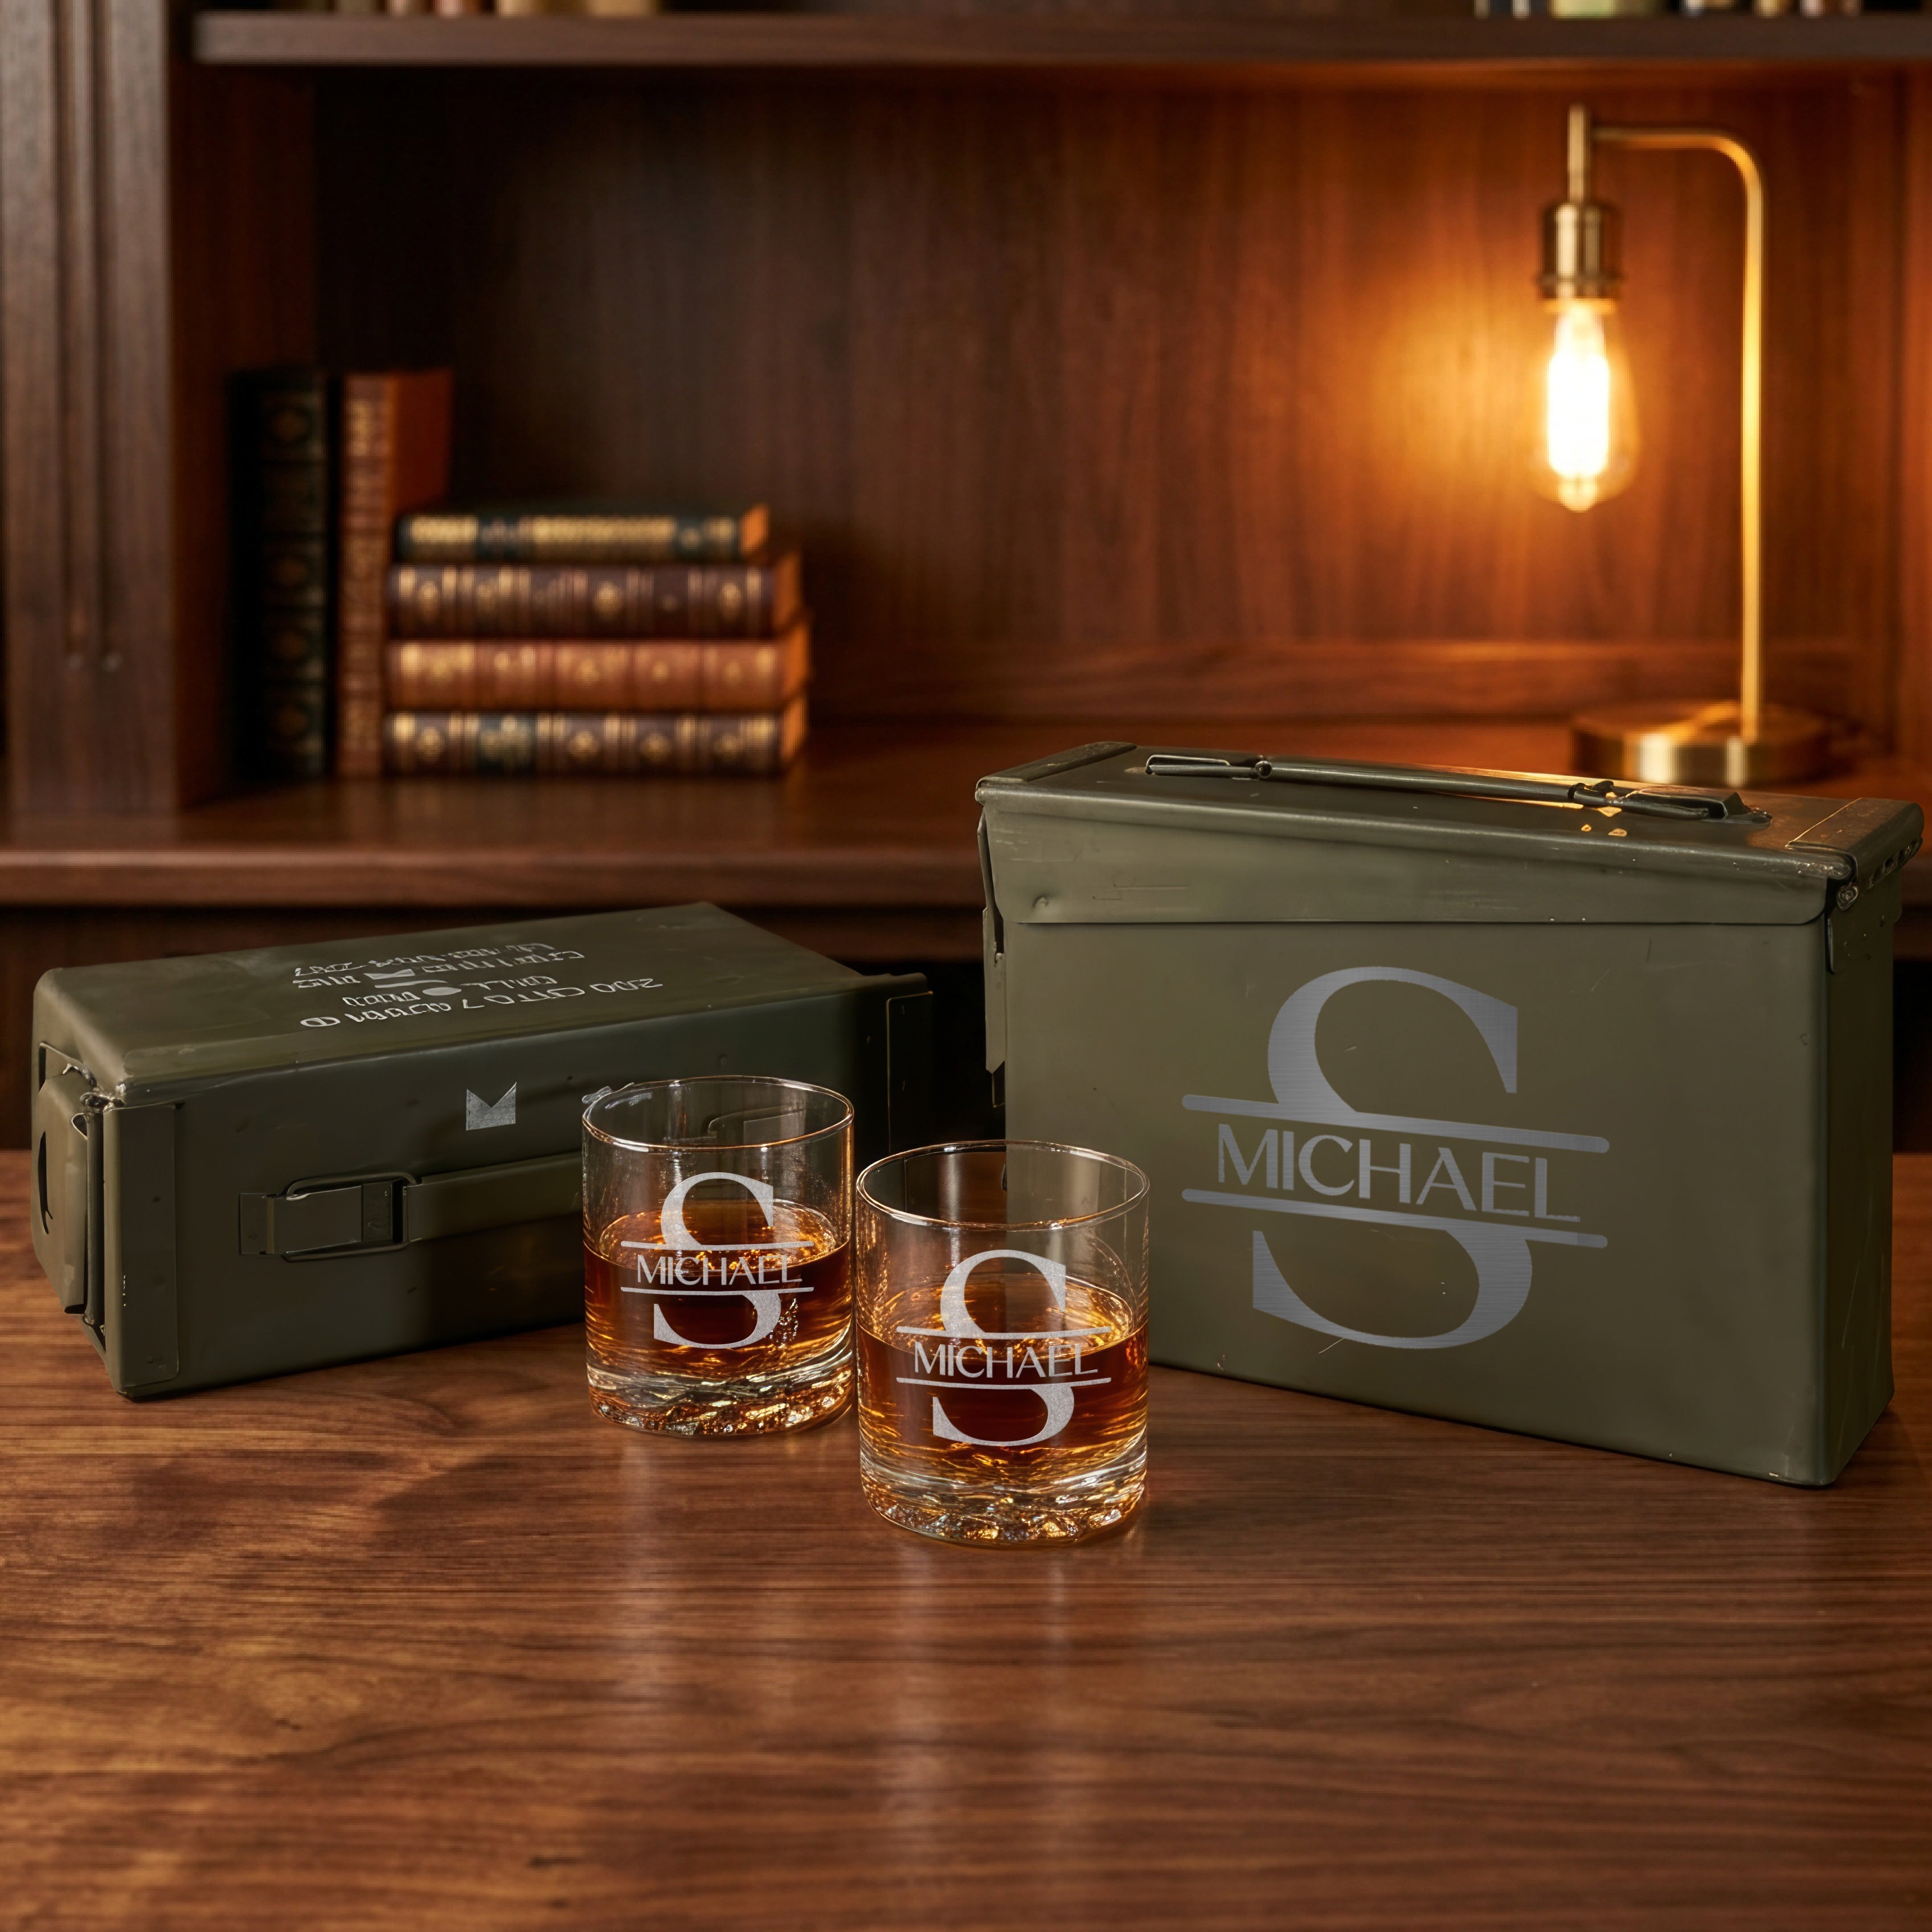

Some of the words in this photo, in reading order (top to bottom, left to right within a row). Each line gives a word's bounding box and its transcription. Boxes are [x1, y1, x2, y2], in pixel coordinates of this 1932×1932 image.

[1218, 1124, 1581, 1223] MICHAEL
[1252, 965, 1533, 1349] S
[637, 1254, 803, 1284] MICHAEL
[653, 1172, 781, 1349] S
[914, 1341, 1099, 1379] MICHAEL
[932, 1249, 1075, 1447] S
